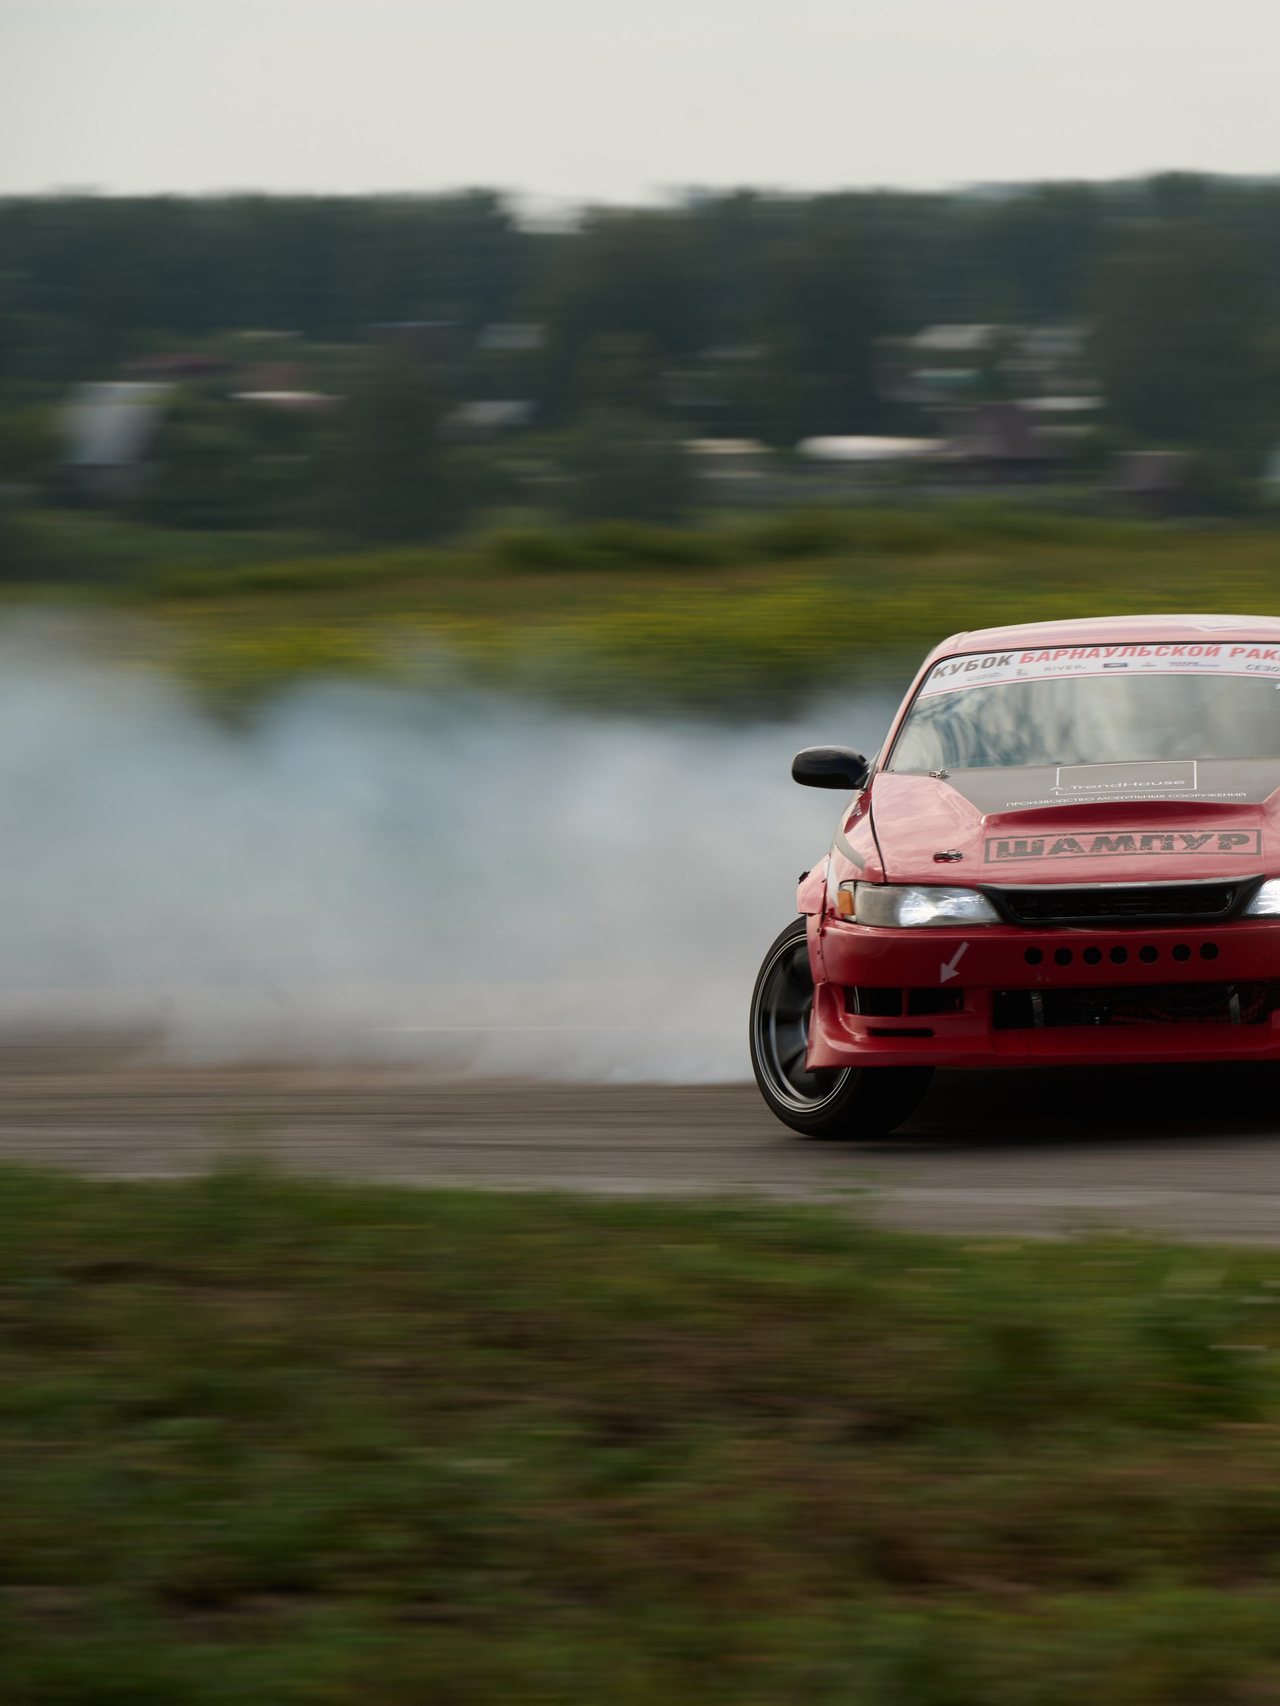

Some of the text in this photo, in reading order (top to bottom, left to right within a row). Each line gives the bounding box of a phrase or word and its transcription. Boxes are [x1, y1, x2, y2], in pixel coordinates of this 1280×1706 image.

[933, 654, 1015, 679] КУБОК
[1019, 643, 1222, 664] БАРНАУЛЬСКОЙ
[1006, 791, 1247, 807] ПРОИЗВОДСТВО МОДУЛЬНЫХ СООРУЖЕНИЙ
[996, 833, 1251, 858] ШАМПУР
